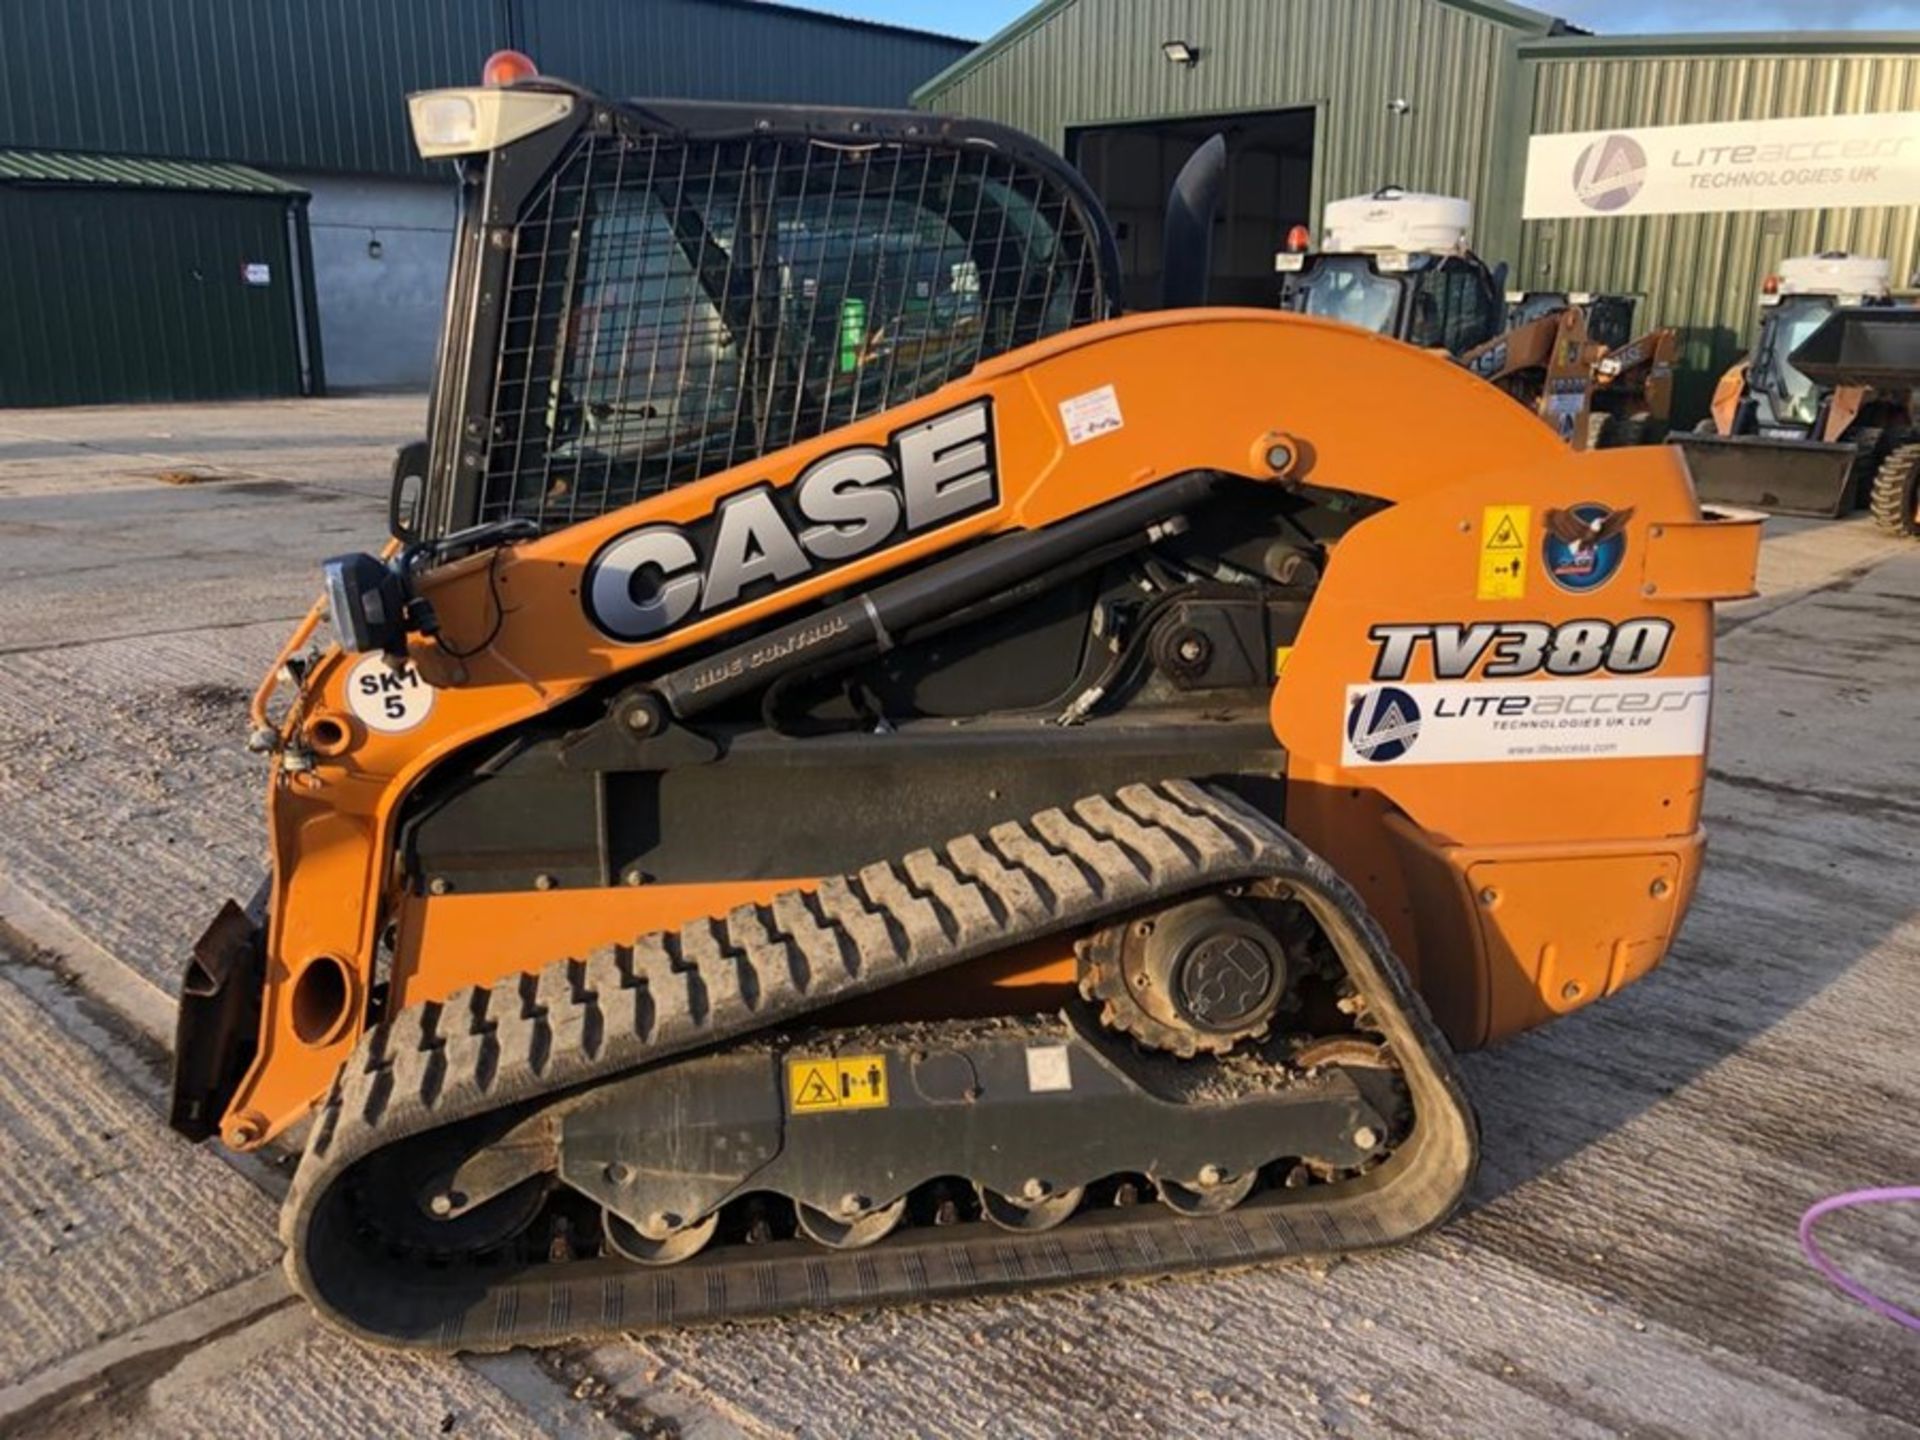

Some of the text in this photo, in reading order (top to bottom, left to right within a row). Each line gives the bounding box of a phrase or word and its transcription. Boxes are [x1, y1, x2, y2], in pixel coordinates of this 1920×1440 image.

[1689, 165, 1881, 189] TECHNOLOGIES UK
[586, 397, 997, 640] CASE
[1369, 618, 1676, 681] TV380
[384, 695, 406, 719] 5
[1492, 717, 1600, 730] TECHNOLOGIES
[1605, 718, 1625, 728] UK
